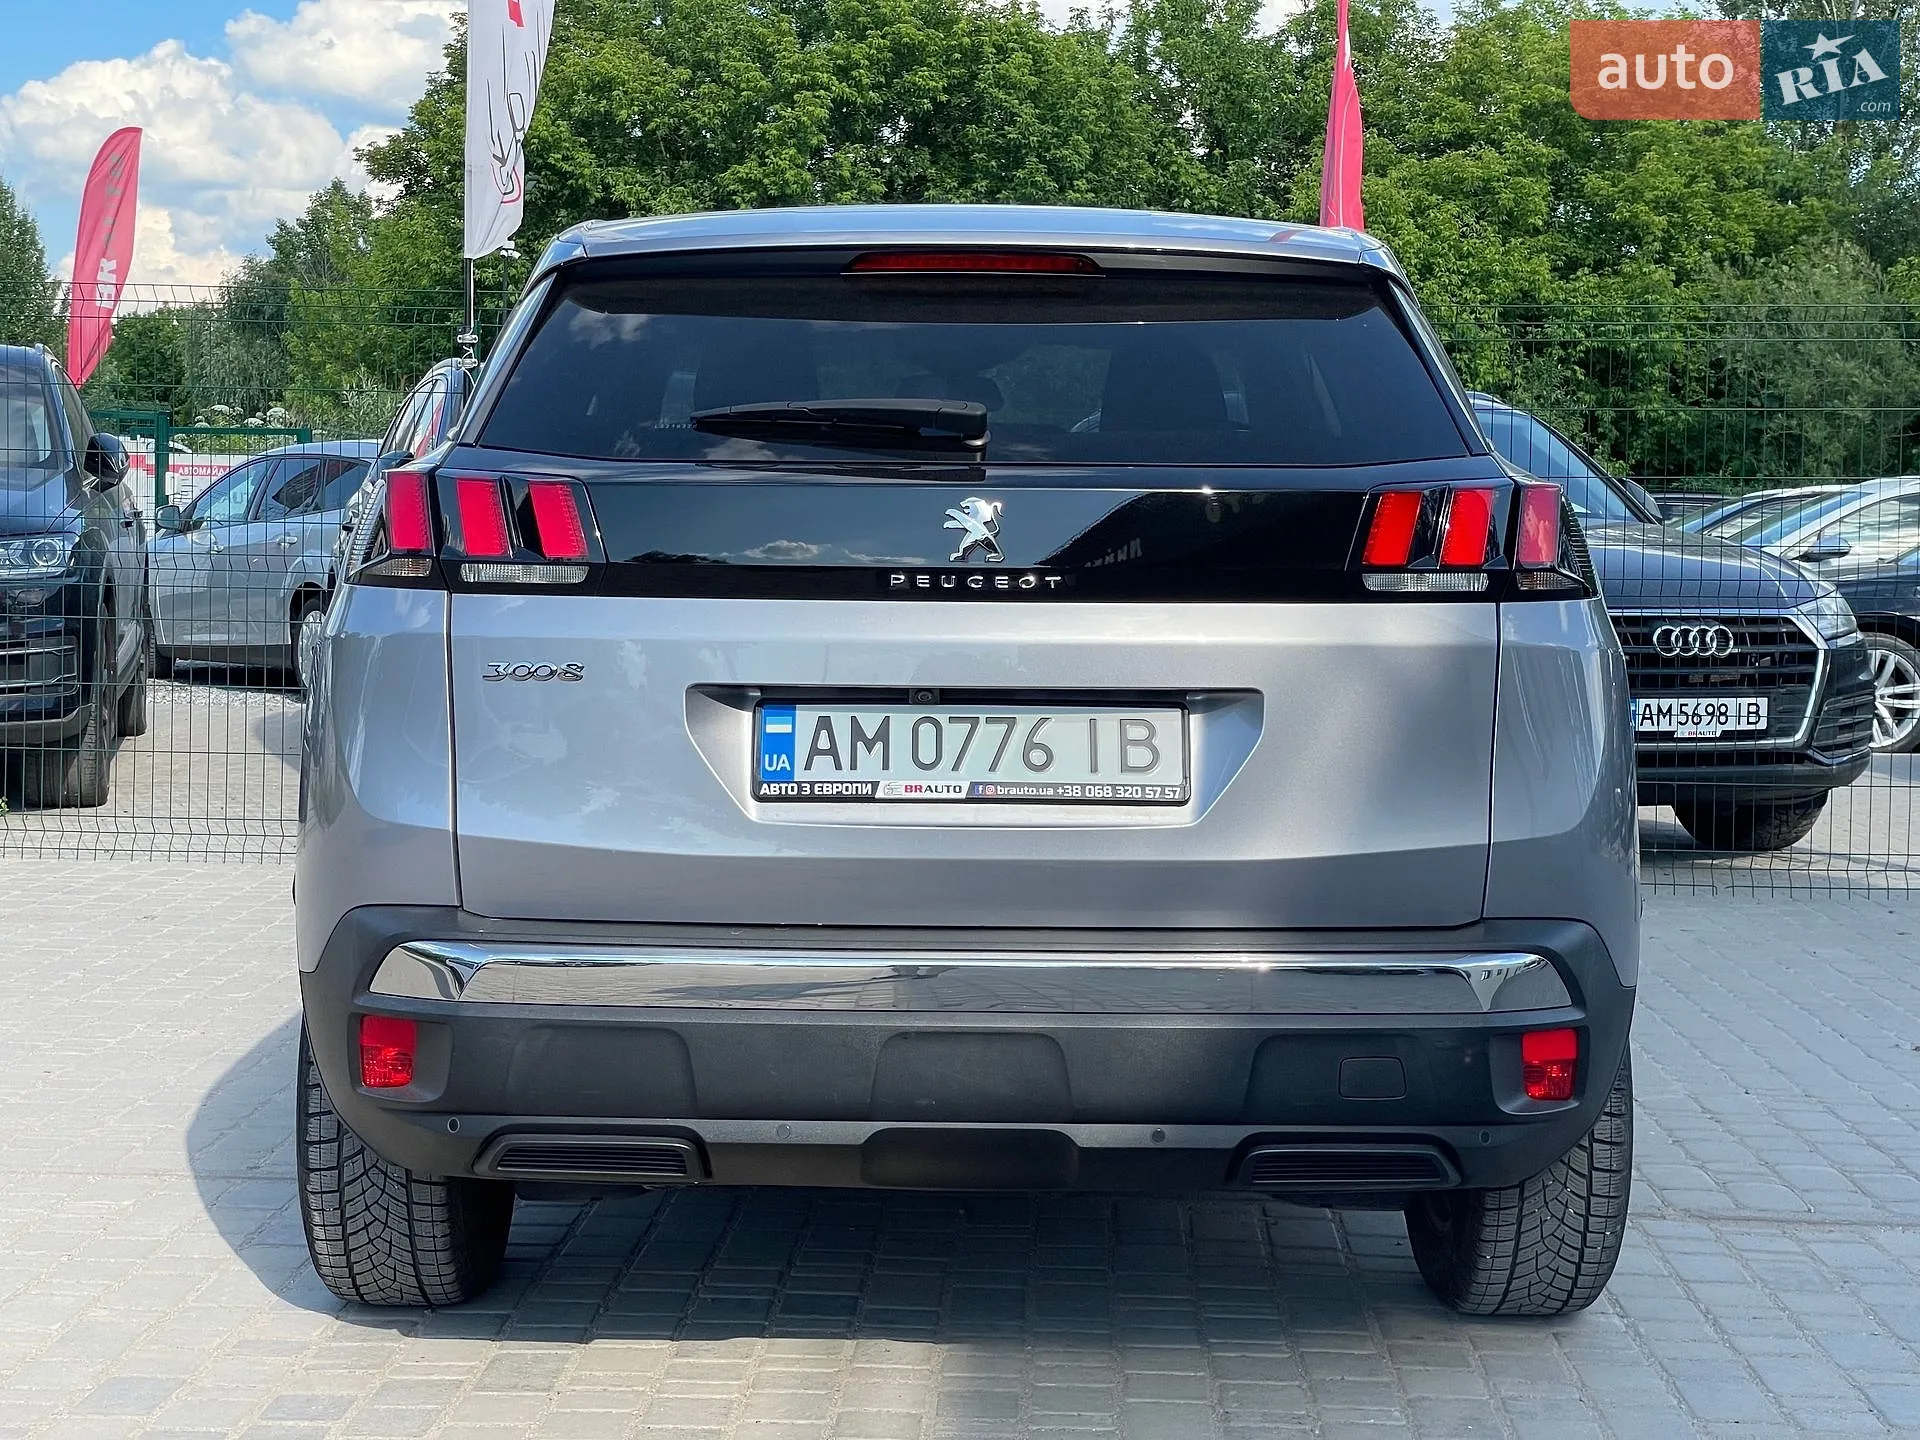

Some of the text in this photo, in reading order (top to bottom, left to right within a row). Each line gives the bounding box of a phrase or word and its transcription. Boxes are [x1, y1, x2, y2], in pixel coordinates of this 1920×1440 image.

[890, 574, 1062, 589] PEUGEOT
[482, 661, 585, 682] 3008
[1640, 702, 1761, 727] AM 5698 IB
[803, 715, 1161, 774] AM 0776 IB
[764, 754, 791, 771] UA
[760, 783, 798, 795] АВТО
[904, 784, 962, 794] BRAUTO
[996, 785, 1180, 799] brauto.ua +38 068 320 57 57
